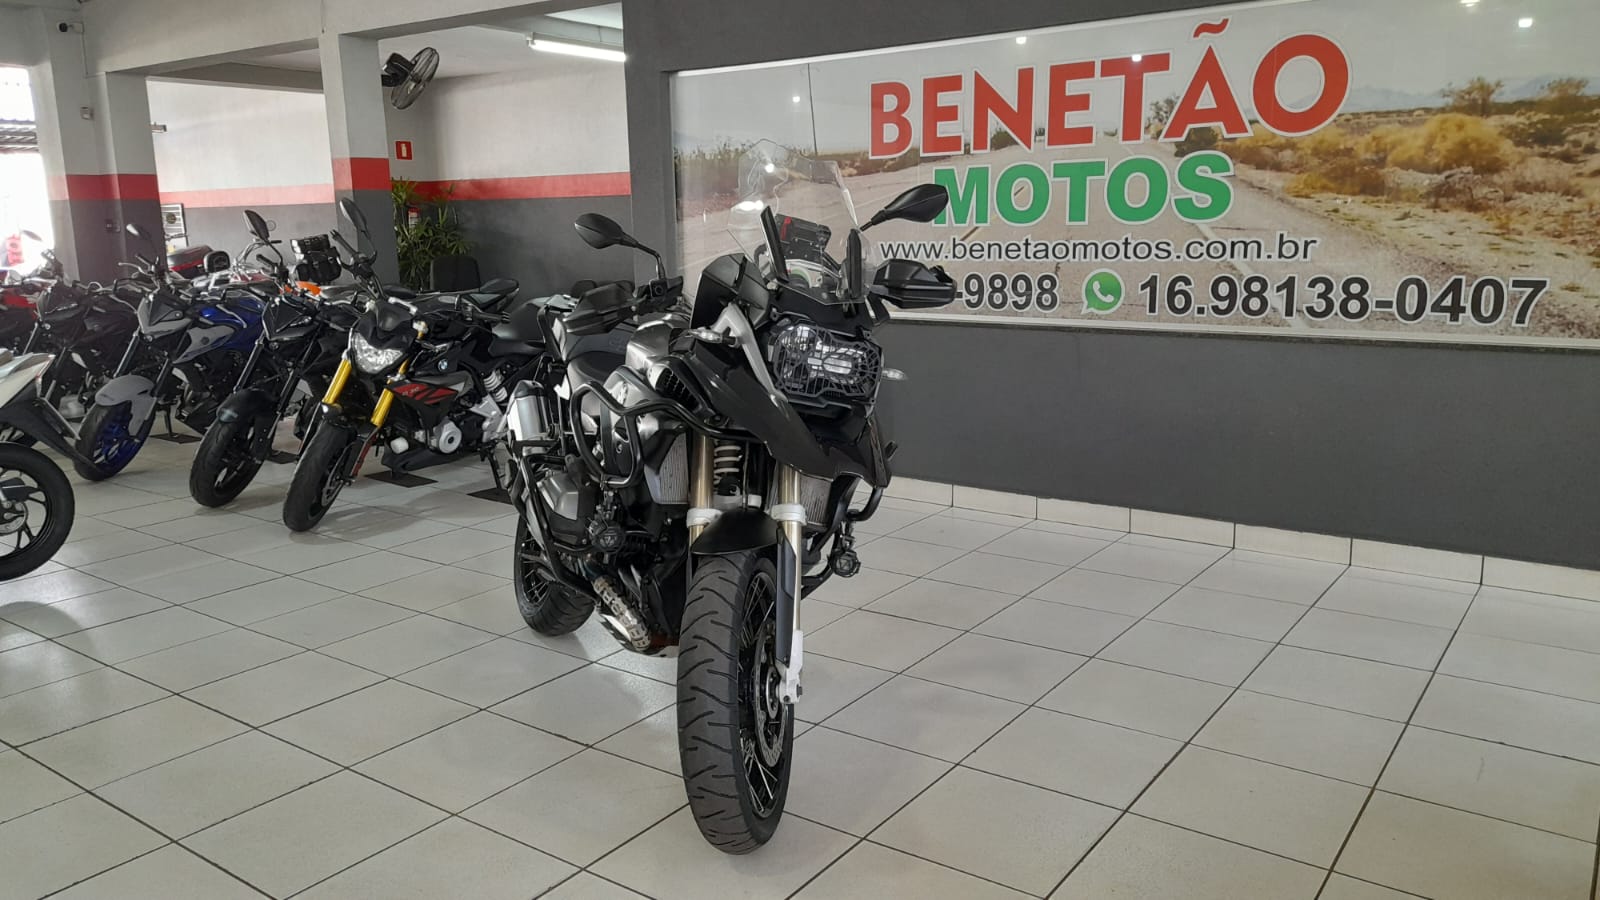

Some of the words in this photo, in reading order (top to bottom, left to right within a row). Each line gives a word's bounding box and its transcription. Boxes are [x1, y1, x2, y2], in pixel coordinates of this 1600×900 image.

[870, 19, 1349, 156] BENETÃO
[933, 154, 1232, 224] MOTOS
[880, 233, 1317, 261] www.benetaomotos.com.br
[1140, 275, 1547, 325] 16.98138-0407
